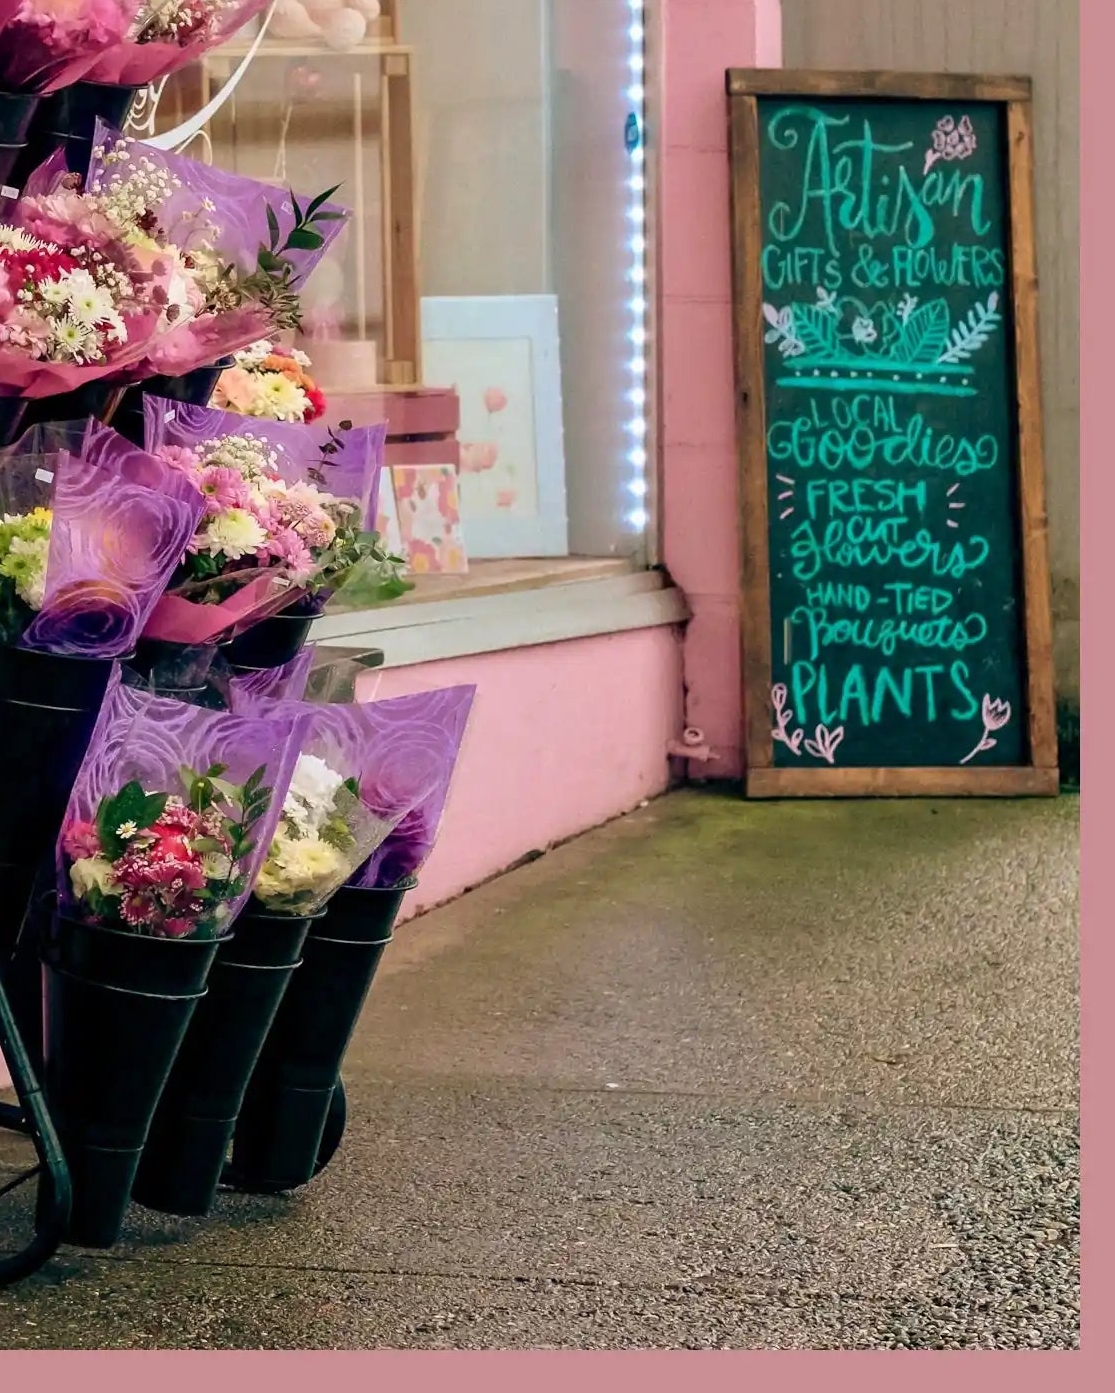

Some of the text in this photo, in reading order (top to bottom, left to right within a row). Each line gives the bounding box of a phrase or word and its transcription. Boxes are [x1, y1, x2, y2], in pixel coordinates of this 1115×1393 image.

[768, 105, 991, 257] Artisan
[851, 243, 890, 288] &
[810, 394, 903, 434] LOCAL
[806, 477, 927, 519] FRESH
[792, 660, 978, 727] PLANTS
